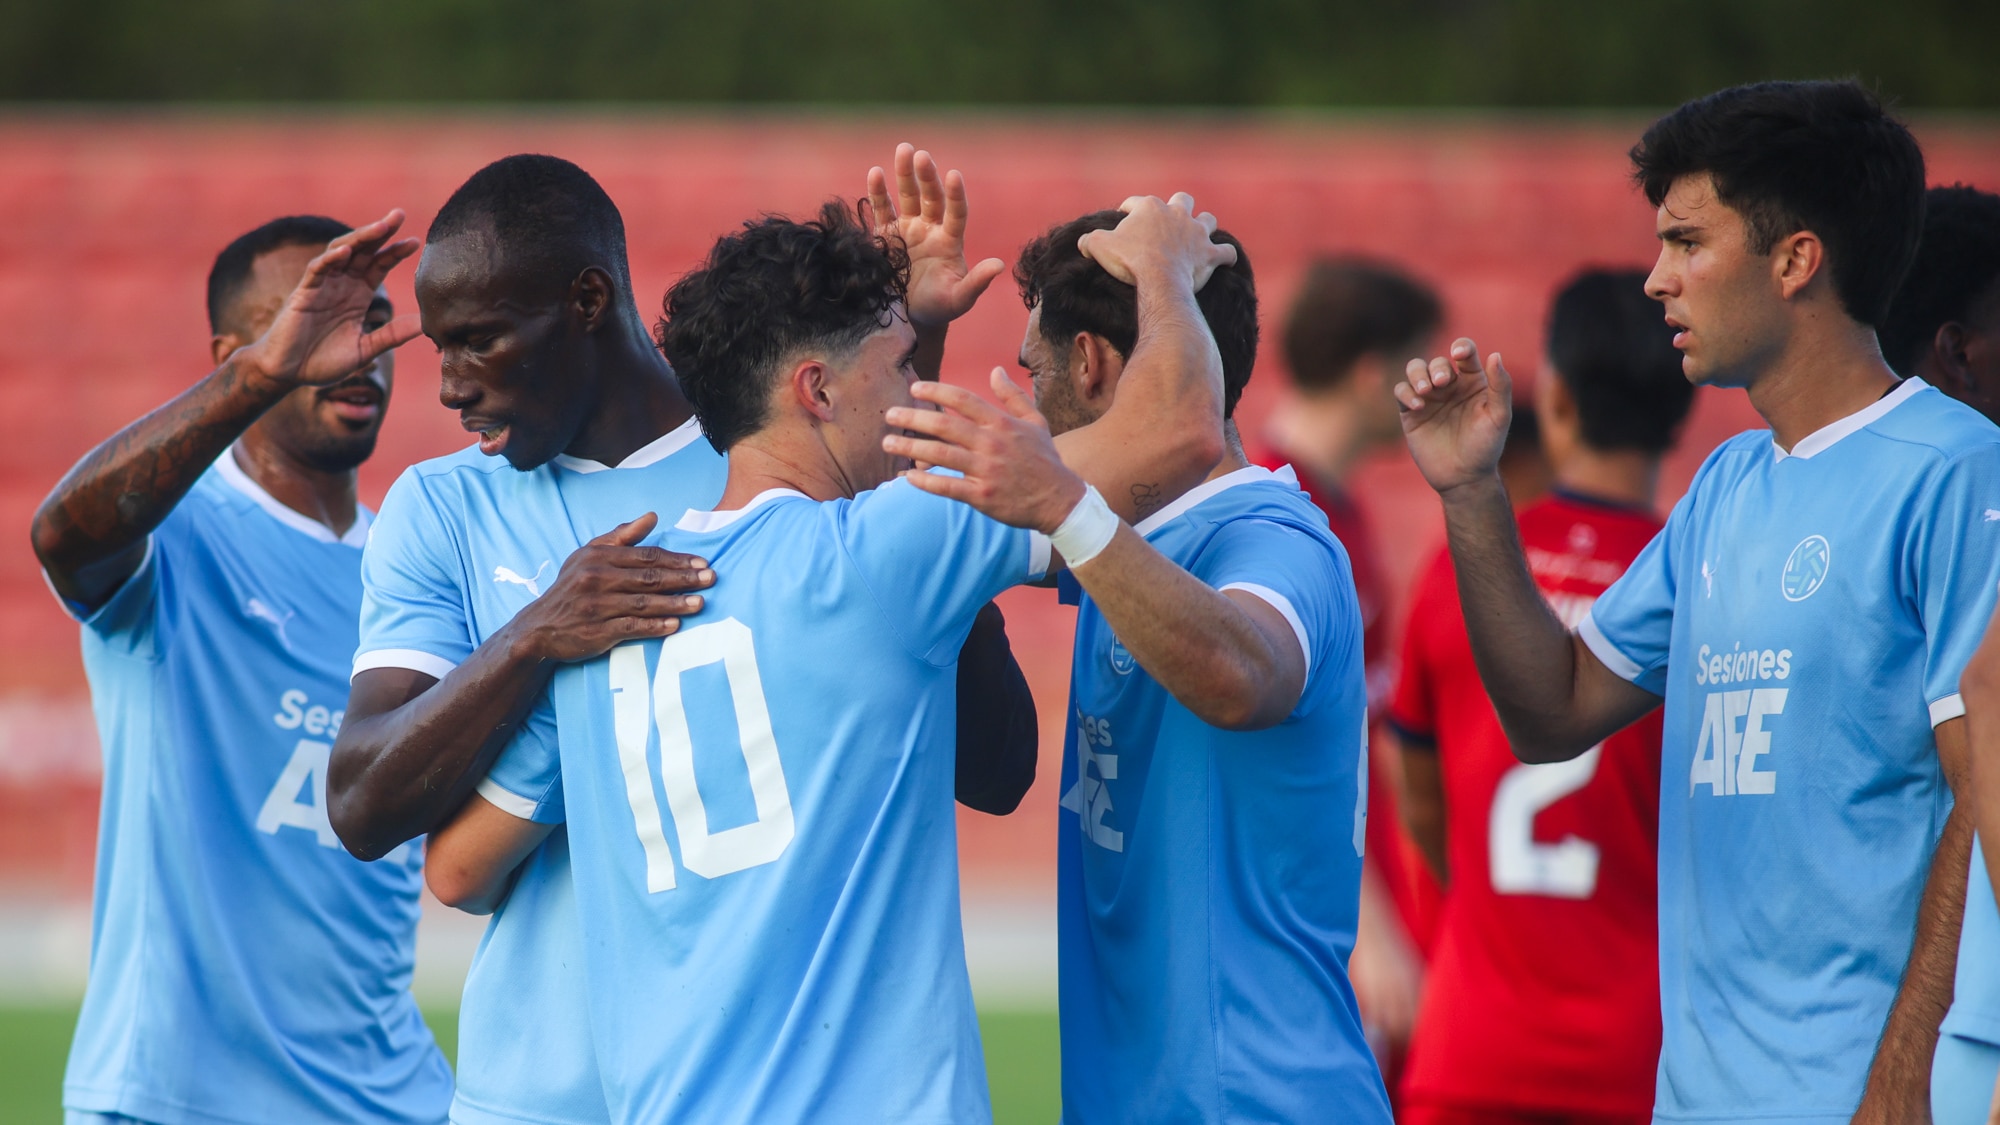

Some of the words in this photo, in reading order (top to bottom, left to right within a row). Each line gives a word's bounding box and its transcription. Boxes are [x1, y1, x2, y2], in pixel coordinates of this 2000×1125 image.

[1696, 641, 1793, 686] Sesiones
[609, 616, 795, 894] 10
[1689, 688, 1789, 798] AFE
[1488, 742, 1601, 900] 2
